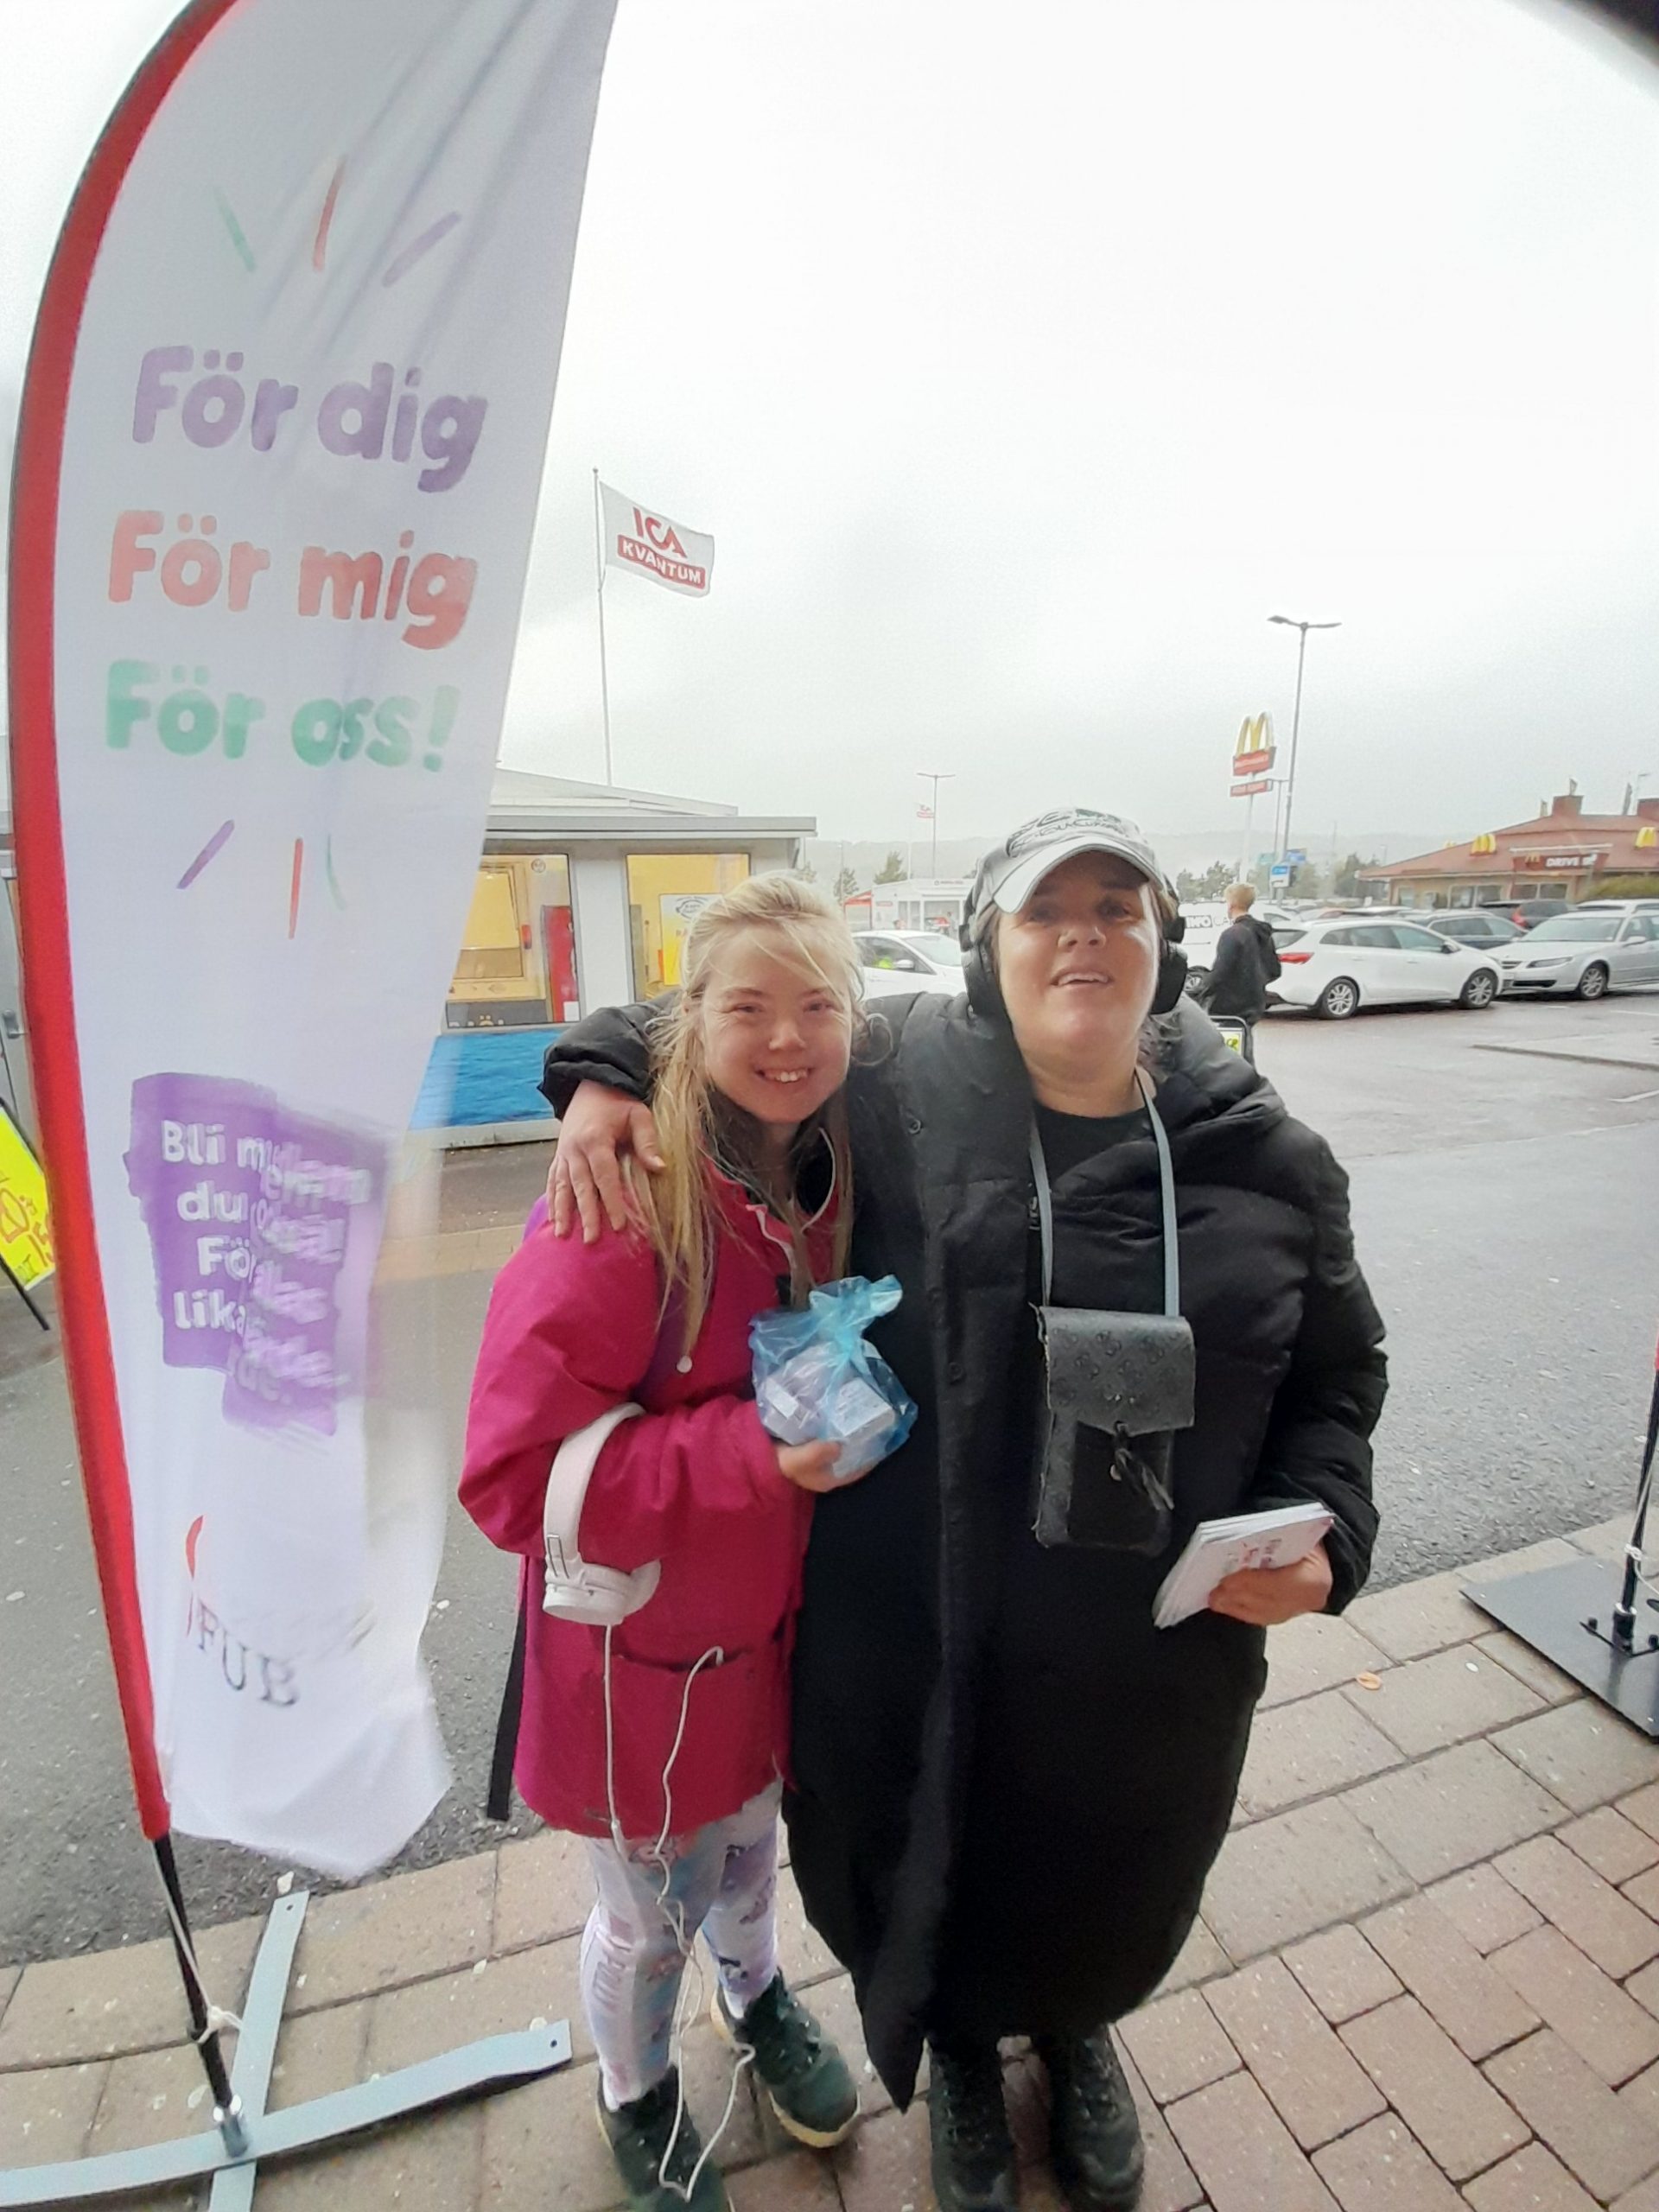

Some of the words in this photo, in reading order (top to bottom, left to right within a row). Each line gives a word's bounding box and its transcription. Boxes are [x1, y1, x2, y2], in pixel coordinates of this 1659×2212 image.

[131, 345, 299, 452] För
[317, 361, 488, 493] dig
[632, 506, 688, 558] ICA
[108, 510, 270, 612] För
[298, 530, 478, 651] mig
[621, 539, 702, 585] KVANTUM
[105, 658, 266, 760] För
[291, 685, 461, 772] oss!
[1546, 856, 1580, 868] DRIVE
[162, 1119, 227, 1166] Bli
[176, 1180, 249, 1224] du
